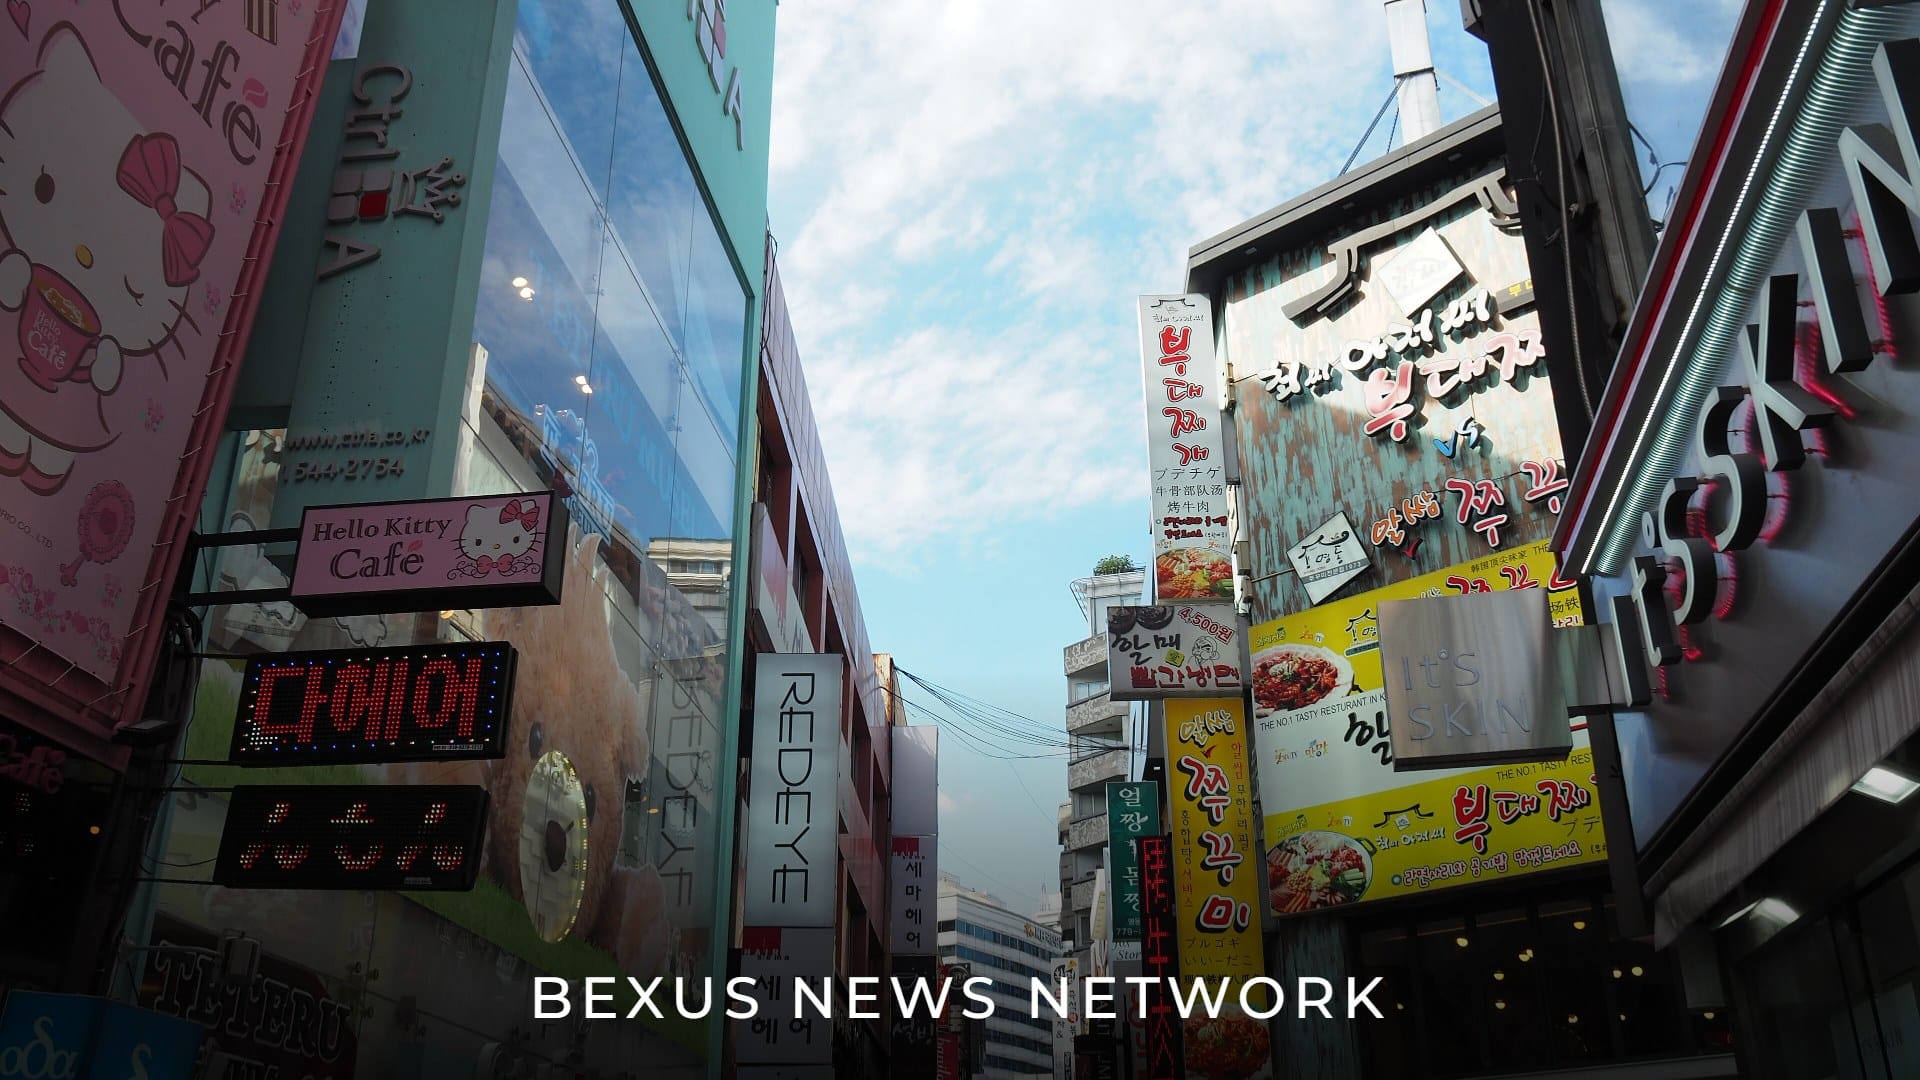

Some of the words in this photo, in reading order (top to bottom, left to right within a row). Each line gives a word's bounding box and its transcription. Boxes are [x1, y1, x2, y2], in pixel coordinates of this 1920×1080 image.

[1159, 325, 1209, 466] 부대찌개
[312, 519, 379, 542] Hello
[384, 516, 452, 540] Kitty
[1178, 606, 1236, 645] 4,500원
[1260, 719, 1275, 732] THE
[1295, 708, 1319, 723] TASTY
[1320, 697, 1368, 717] RESTURANT
[1408, 697, 1531, 741] SKIN
[772, 672, 816, 905] REDEYE
[1495, 769, 1515, 782] THE
[1177, 755, 1251, 931] 쭈꾸미
[905, 862, 922, 949] 세마헤어
